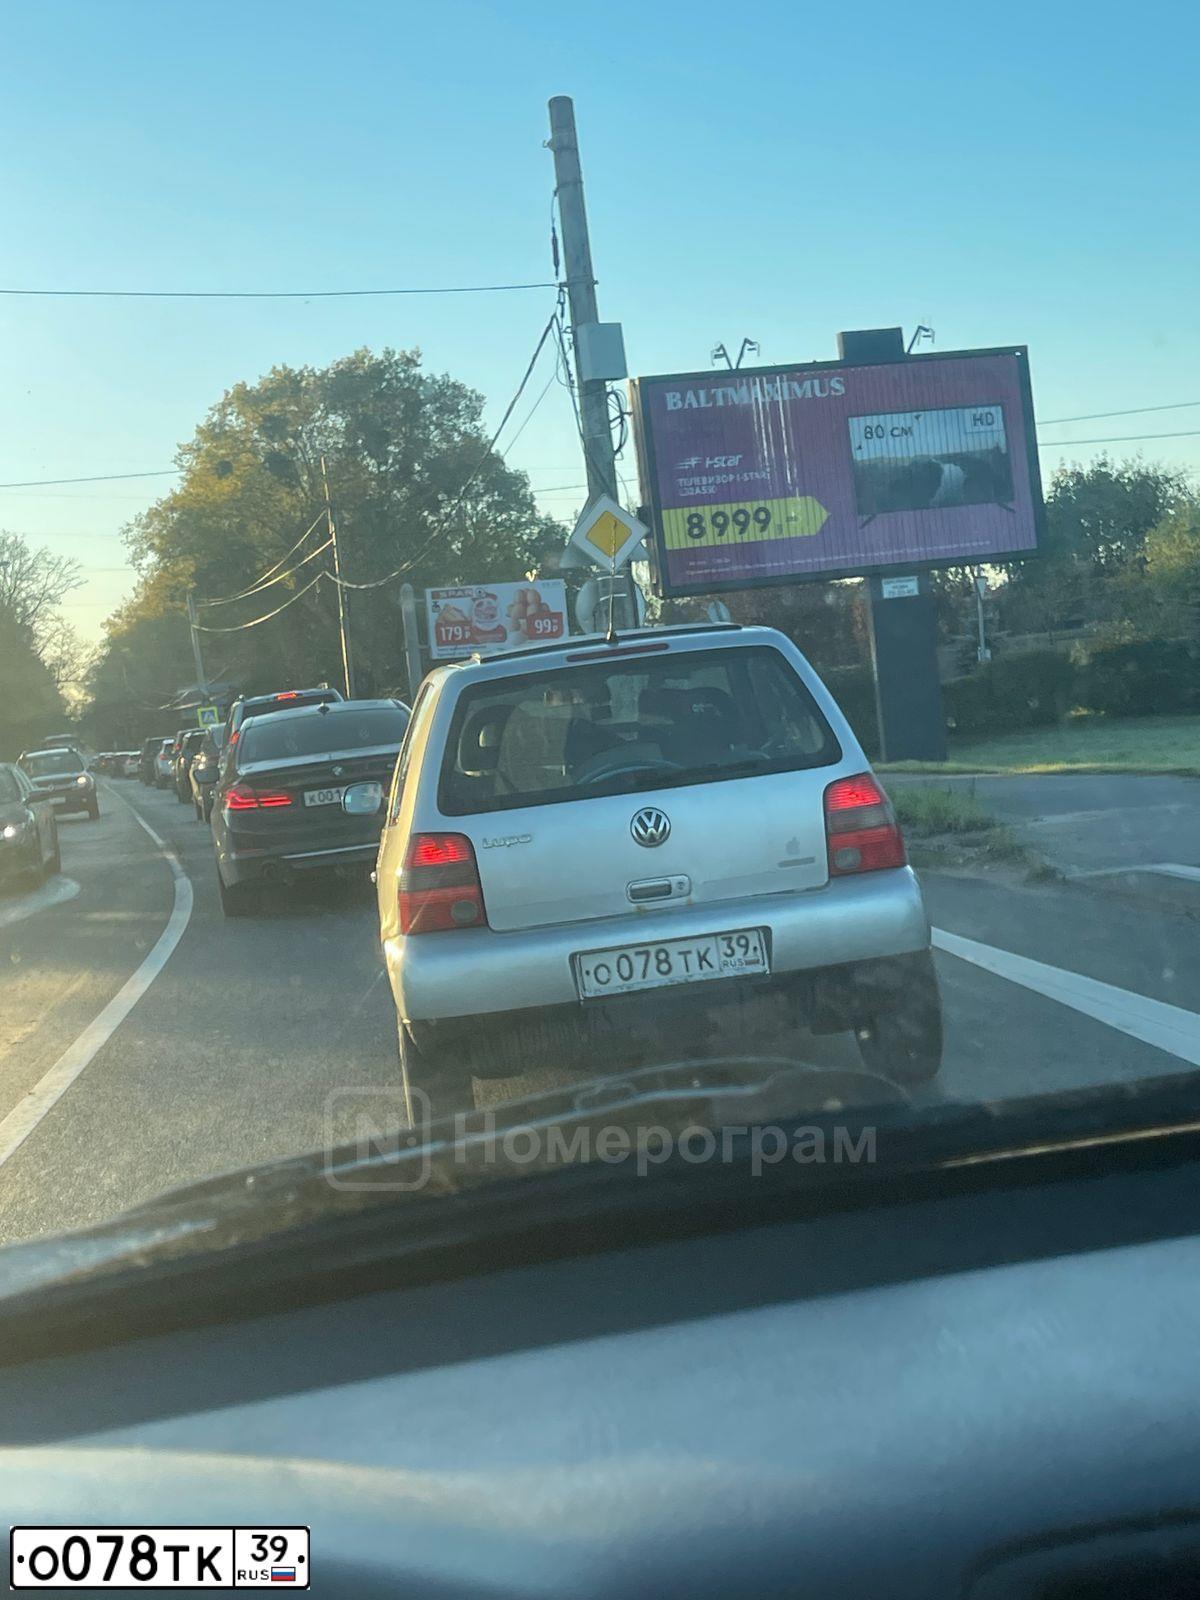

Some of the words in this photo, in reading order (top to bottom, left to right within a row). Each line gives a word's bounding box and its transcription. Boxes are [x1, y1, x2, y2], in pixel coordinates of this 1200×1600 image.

[665, 377, 846, 411] BALTMAXIMUS
[972, 412, 995, 427] HD
[864, 424, 885, 440] 80
[439, 588, 473, 599] SPAR
[440, 626, 463, 641] 179
[534, 619, 552, 634] 99
[721, 935, 750, 958] 39
[722, 959, 744, 969] RUS
